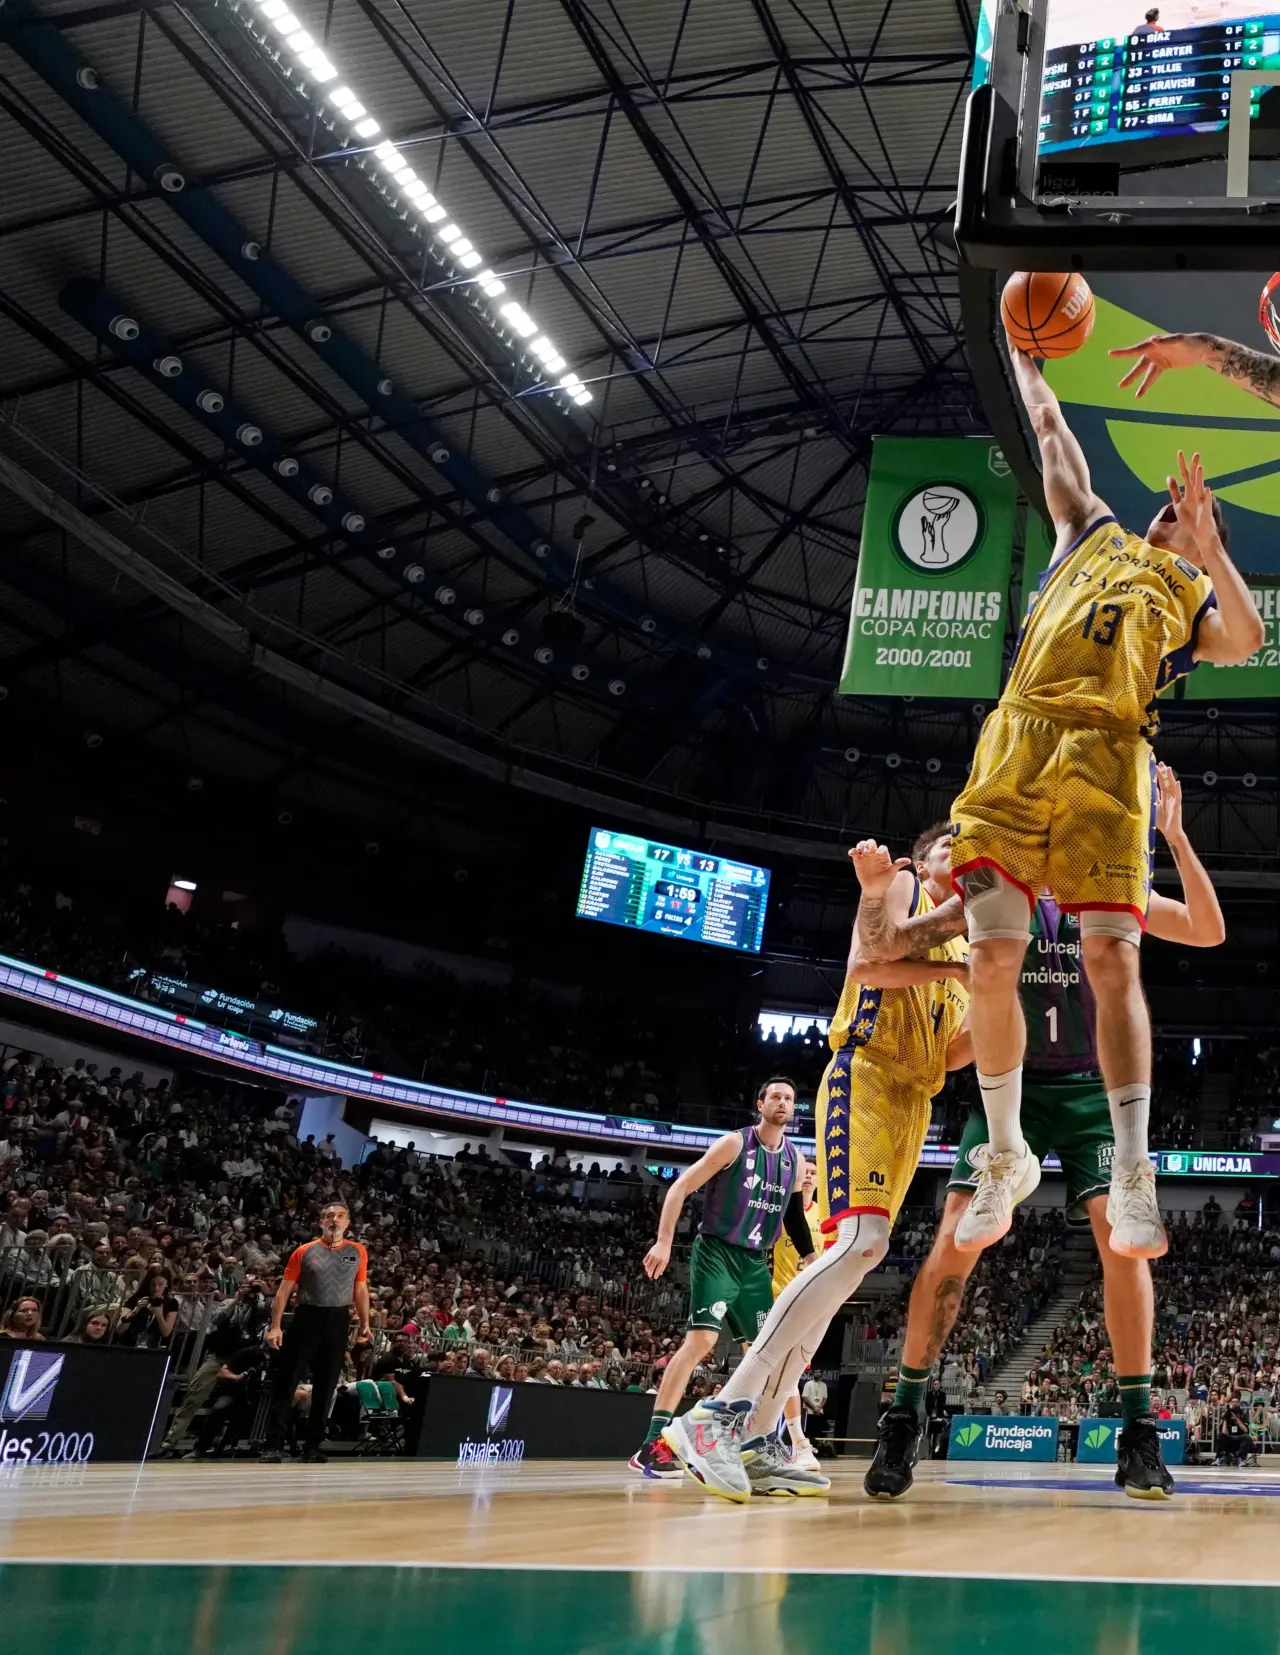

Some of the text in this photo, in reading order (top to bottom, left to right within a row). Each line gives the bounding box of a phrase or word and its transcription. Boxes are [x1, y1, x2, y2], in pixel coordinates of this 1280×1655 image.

[1131, 45, 1192, 61] 11 CARTER
[1128, 63, 1182, 78] 33 TILLIE
[1127, 78, 1195, 93] 45 KRAVISH
[1126, 96, 1183, 111] 55 PERRY
[1124, 112, 1174, 128] 77 SIMA
[1043, 175, 1076, 189] liga
[856, 588, 1001, 621] CAMPEONES
[861, 619, 991, 639] COPA KORAC
[1082, 602, 1122, 645] 13
[876, 648, 971, 667] 2000/2001
[654, 849, 714, 872] 17 VS 13
[1106, 863, 1137, 872] andorra
[1106, 872, 1137, 880] telecom
[667, 884, 696, 901] 1:59
[684, 917, 692, 925] 4
[219, 993, 255, 1009] Fundación
[284, 1013, 317, 1027] Fundación
[931, 1000, 945, 1036] 4
[1046, 1007, 1057, 1042] 1
[794, 1103, 809, 1111] caja
[622, 1121, 655, 1133] Carranque
[1193, 1156, 1251, 1173] UNICAJA
[748, 1223, 762, 1244] 4
[986, 1425, 1051, 1438] Fundación
[459, 1437, 524, 1460] visuales2000
[985, 1437, 1032, 1452] Unicaja
